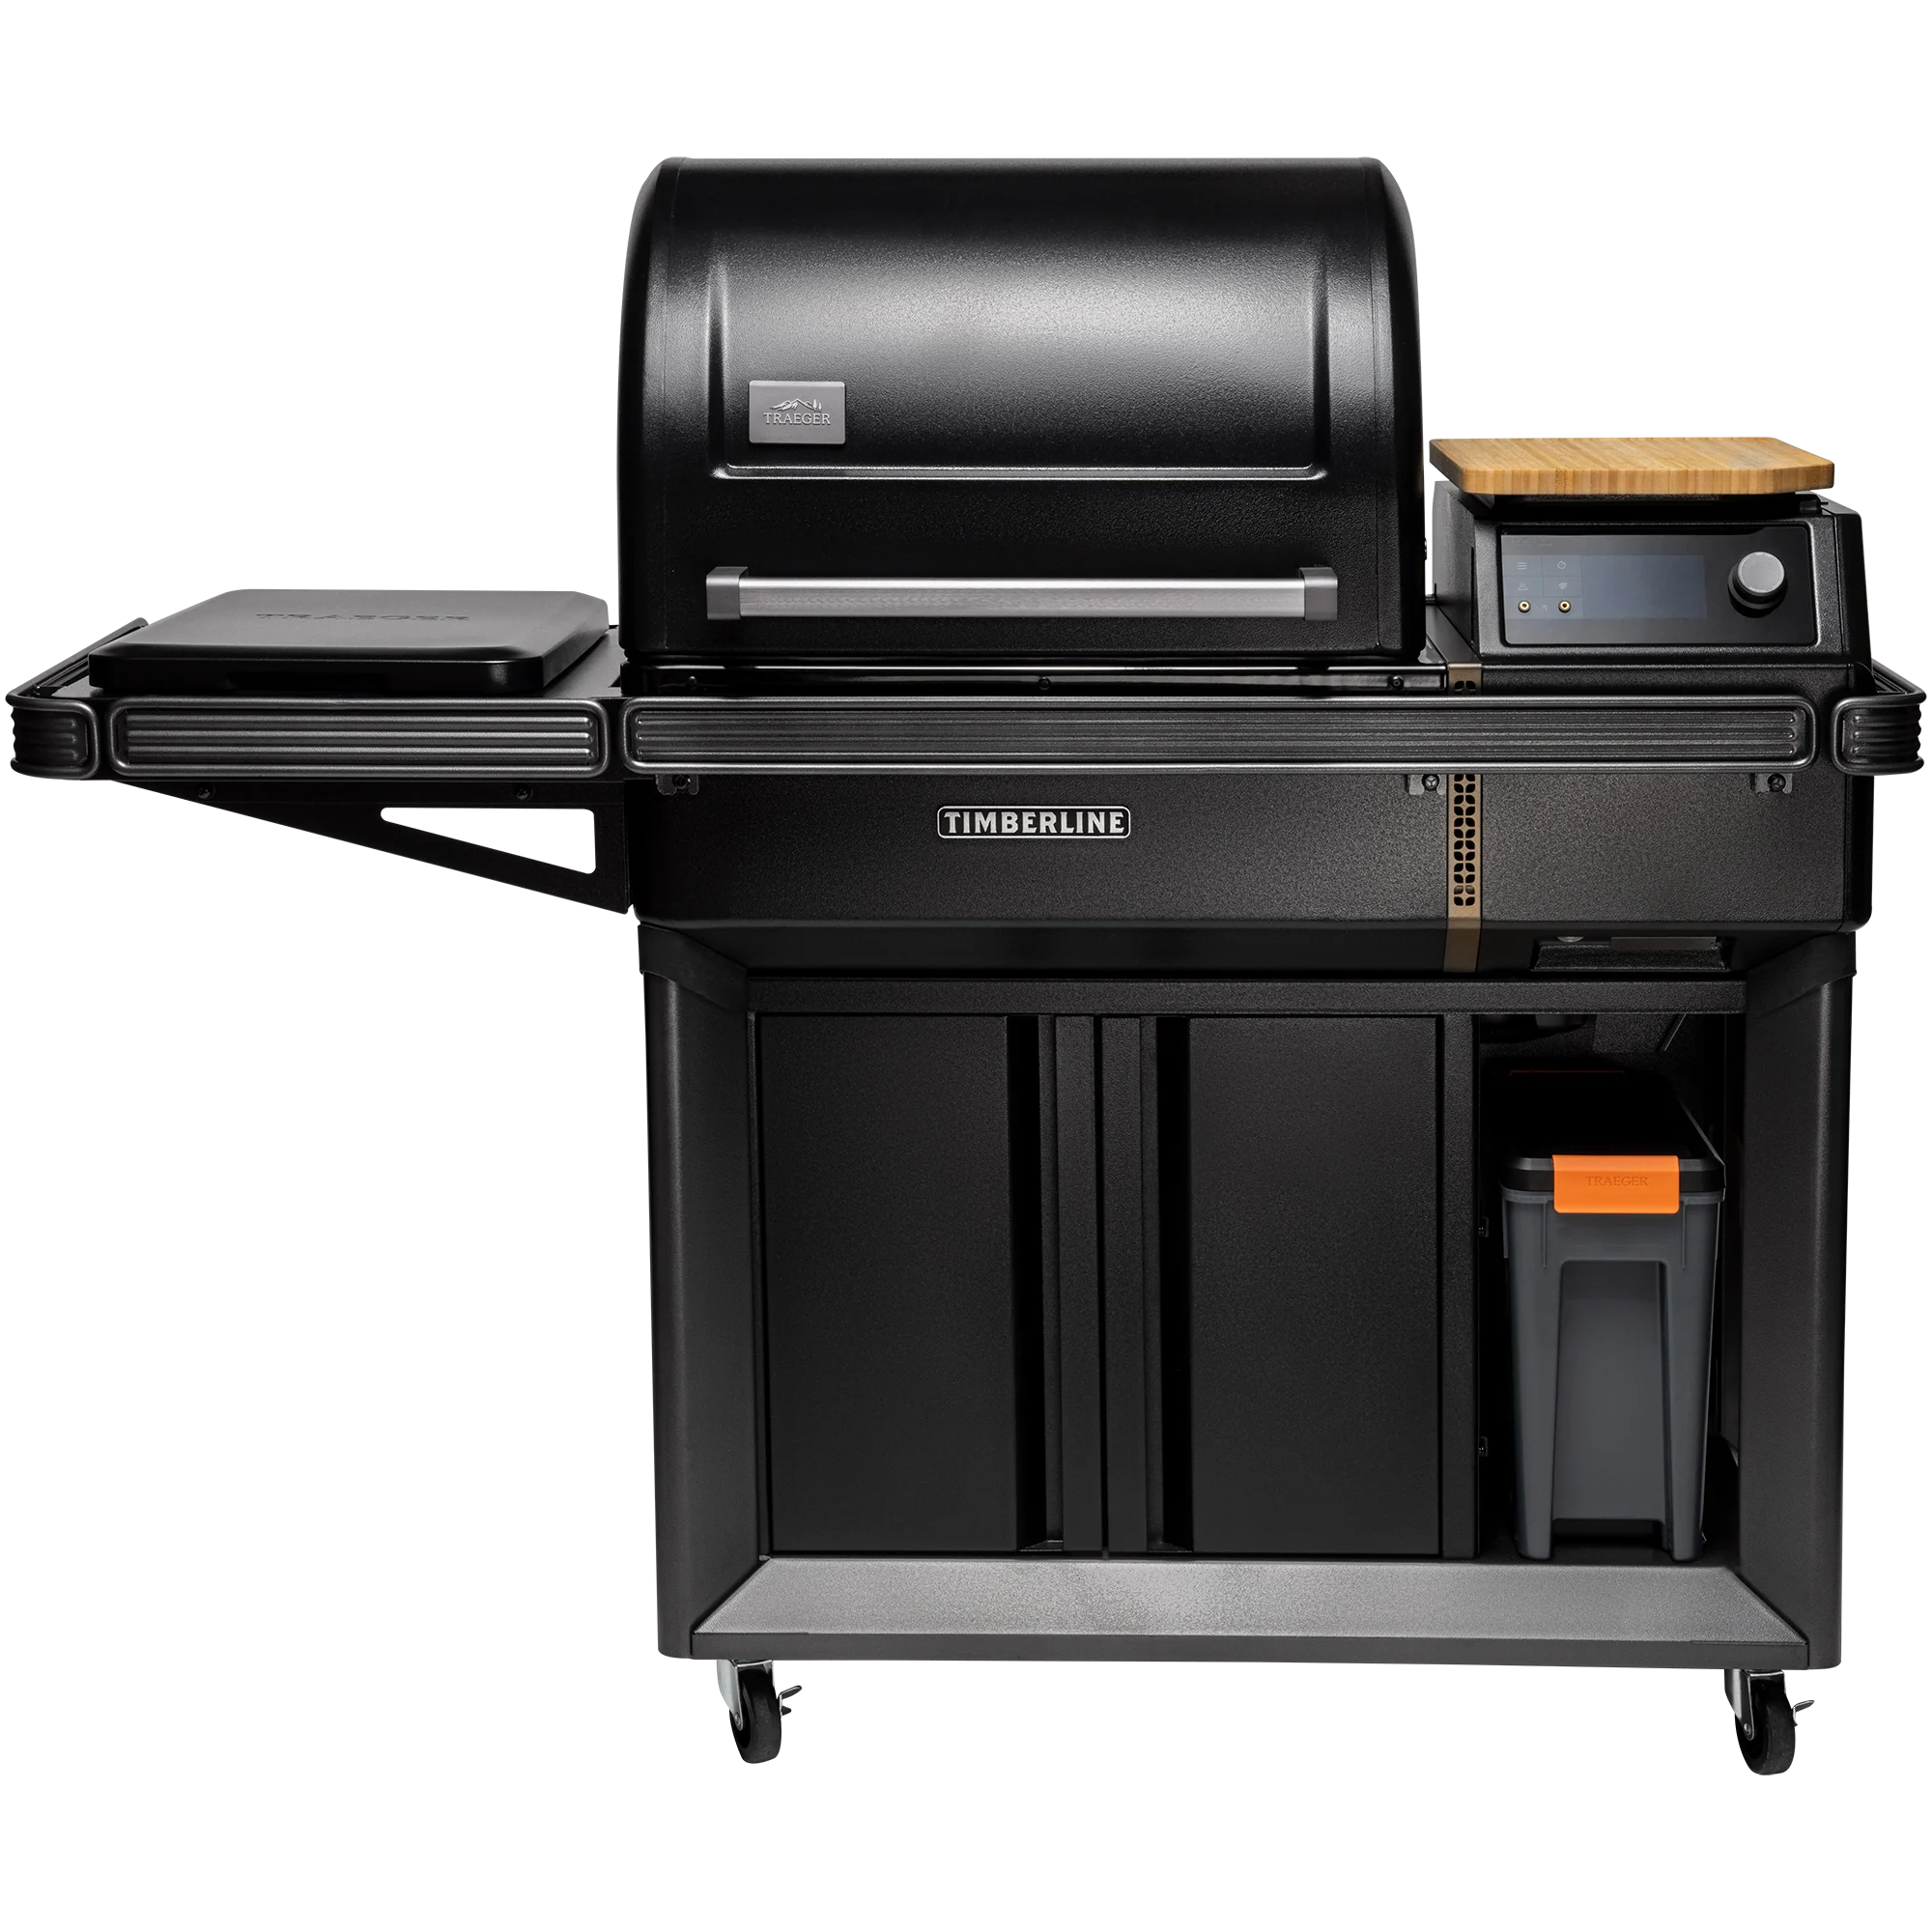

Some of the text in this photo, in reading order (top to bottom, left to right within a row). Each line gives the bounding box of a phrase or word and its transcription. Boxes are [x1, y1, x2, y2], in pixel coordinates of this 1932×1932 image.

[763, 412, 831, 425] TRAEGER
[943, 811, 1124, 834] TIMBERLINE
[1585, 1176, 1649, 1186] TRAEGER
